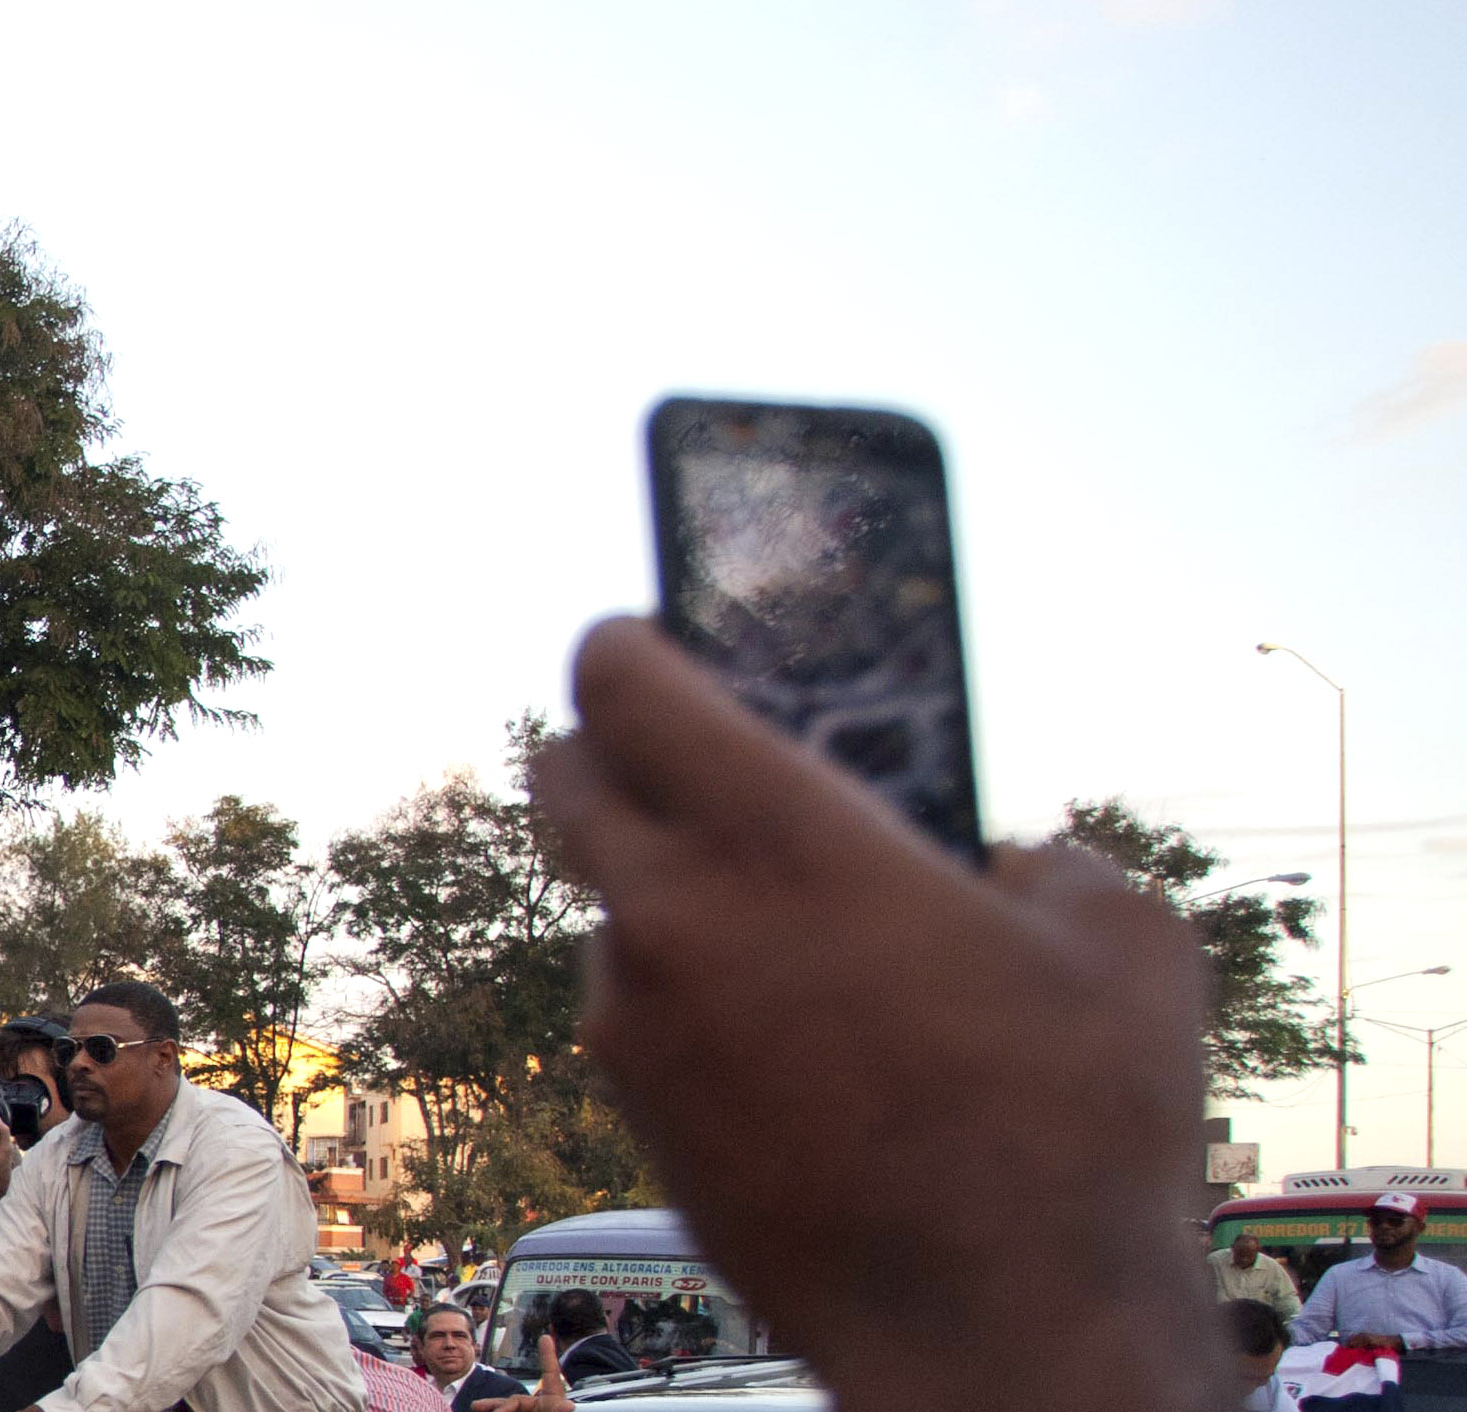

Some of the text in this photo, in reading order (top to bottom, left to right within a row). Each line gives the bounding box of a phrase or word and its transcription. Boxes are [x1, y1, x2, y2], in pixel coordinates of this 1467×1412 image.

[1242, 1222, 1330, 1237] CORREDOR
[516, 1261, 571, 1272] CORREDOR
[602, 1262, 672, 1275] ALTAGRACIA
[681, 1264, 707, 1276] KEN
[536, 1275, 663, 1287] DUARTE CON PARIS
